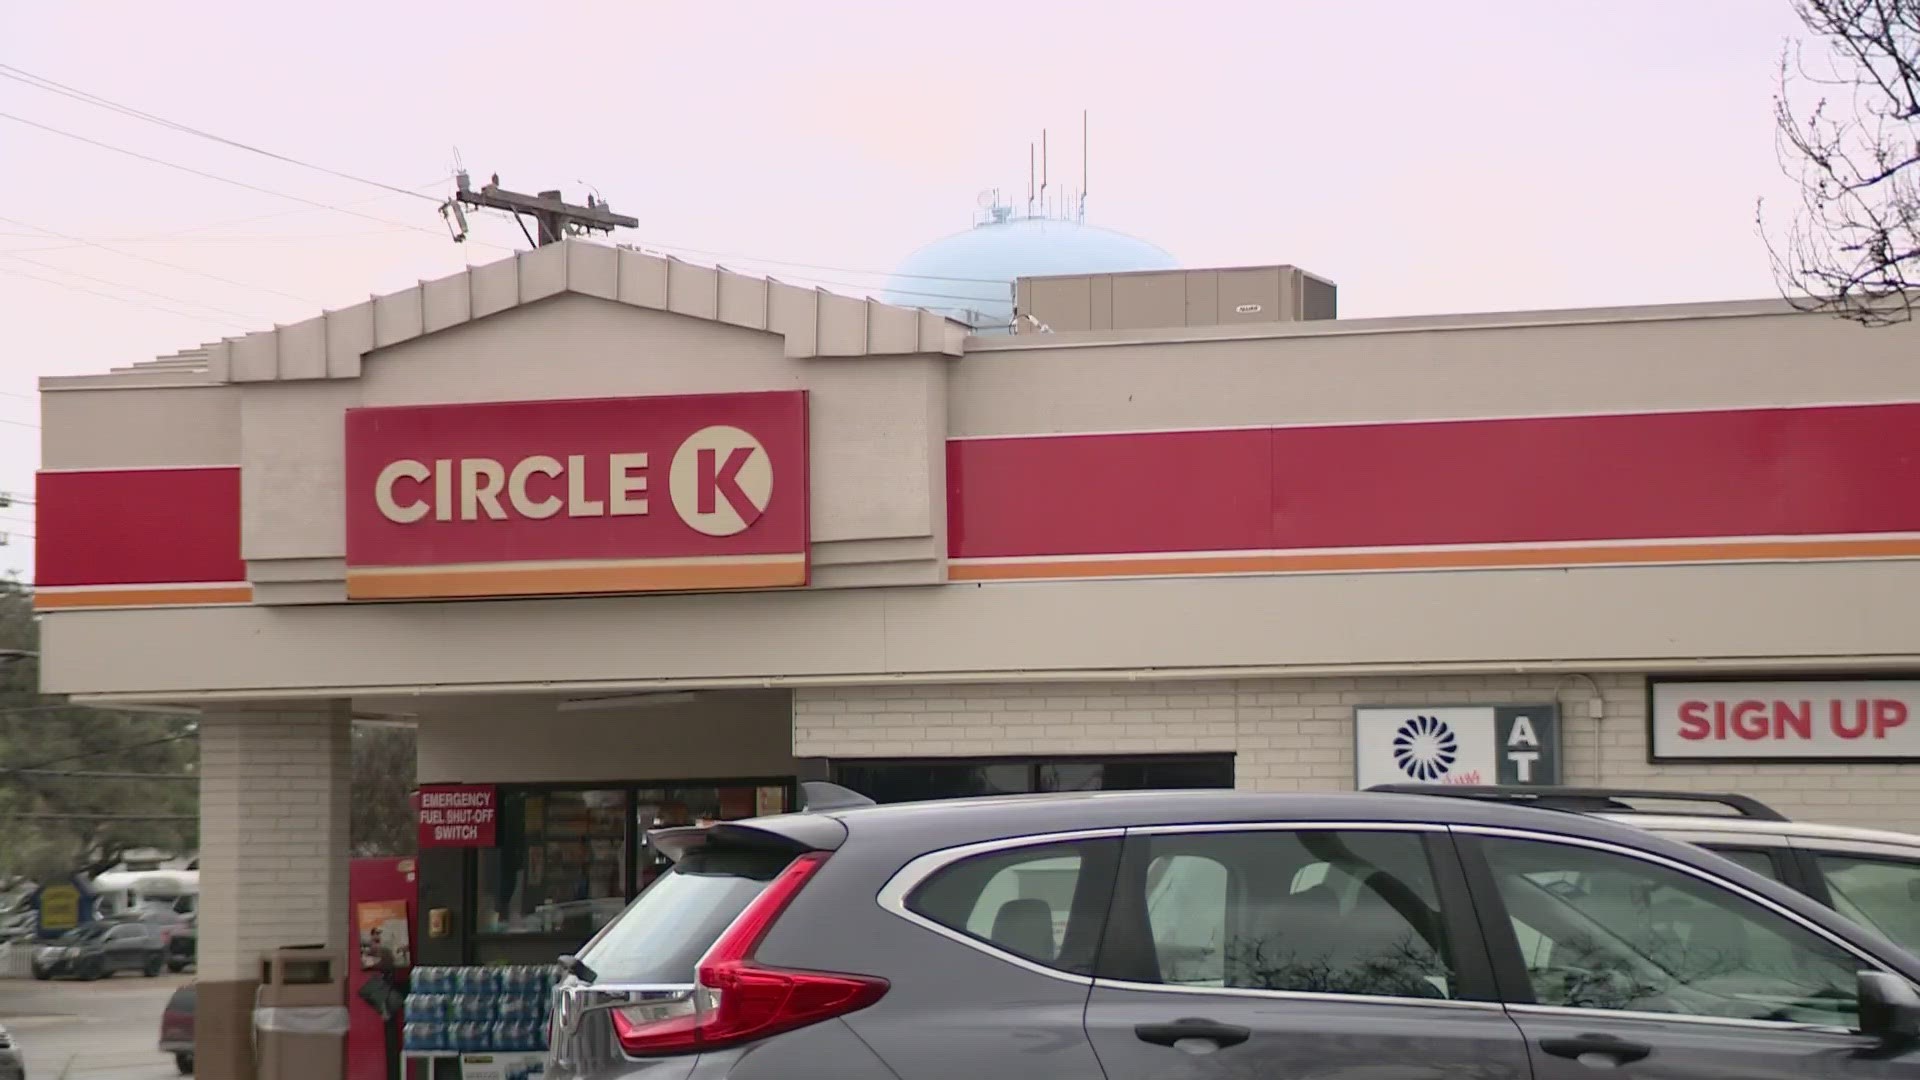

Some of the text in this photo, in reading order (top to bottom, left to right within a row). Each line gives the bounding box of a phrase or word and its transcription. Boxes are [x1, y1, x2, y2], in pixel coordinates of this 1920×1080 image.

[375, 447, 763, 528] CIRCLE K
[1677, 699, 1908, 740] SIGN UP
[1507, 715, 1540, 798] AT
[422, 792, 491, 808] EMERGENCY
[420, 808, 494, 824] FUEL SHUT-OFF
[434, 825, 478, 841] SWITCH
